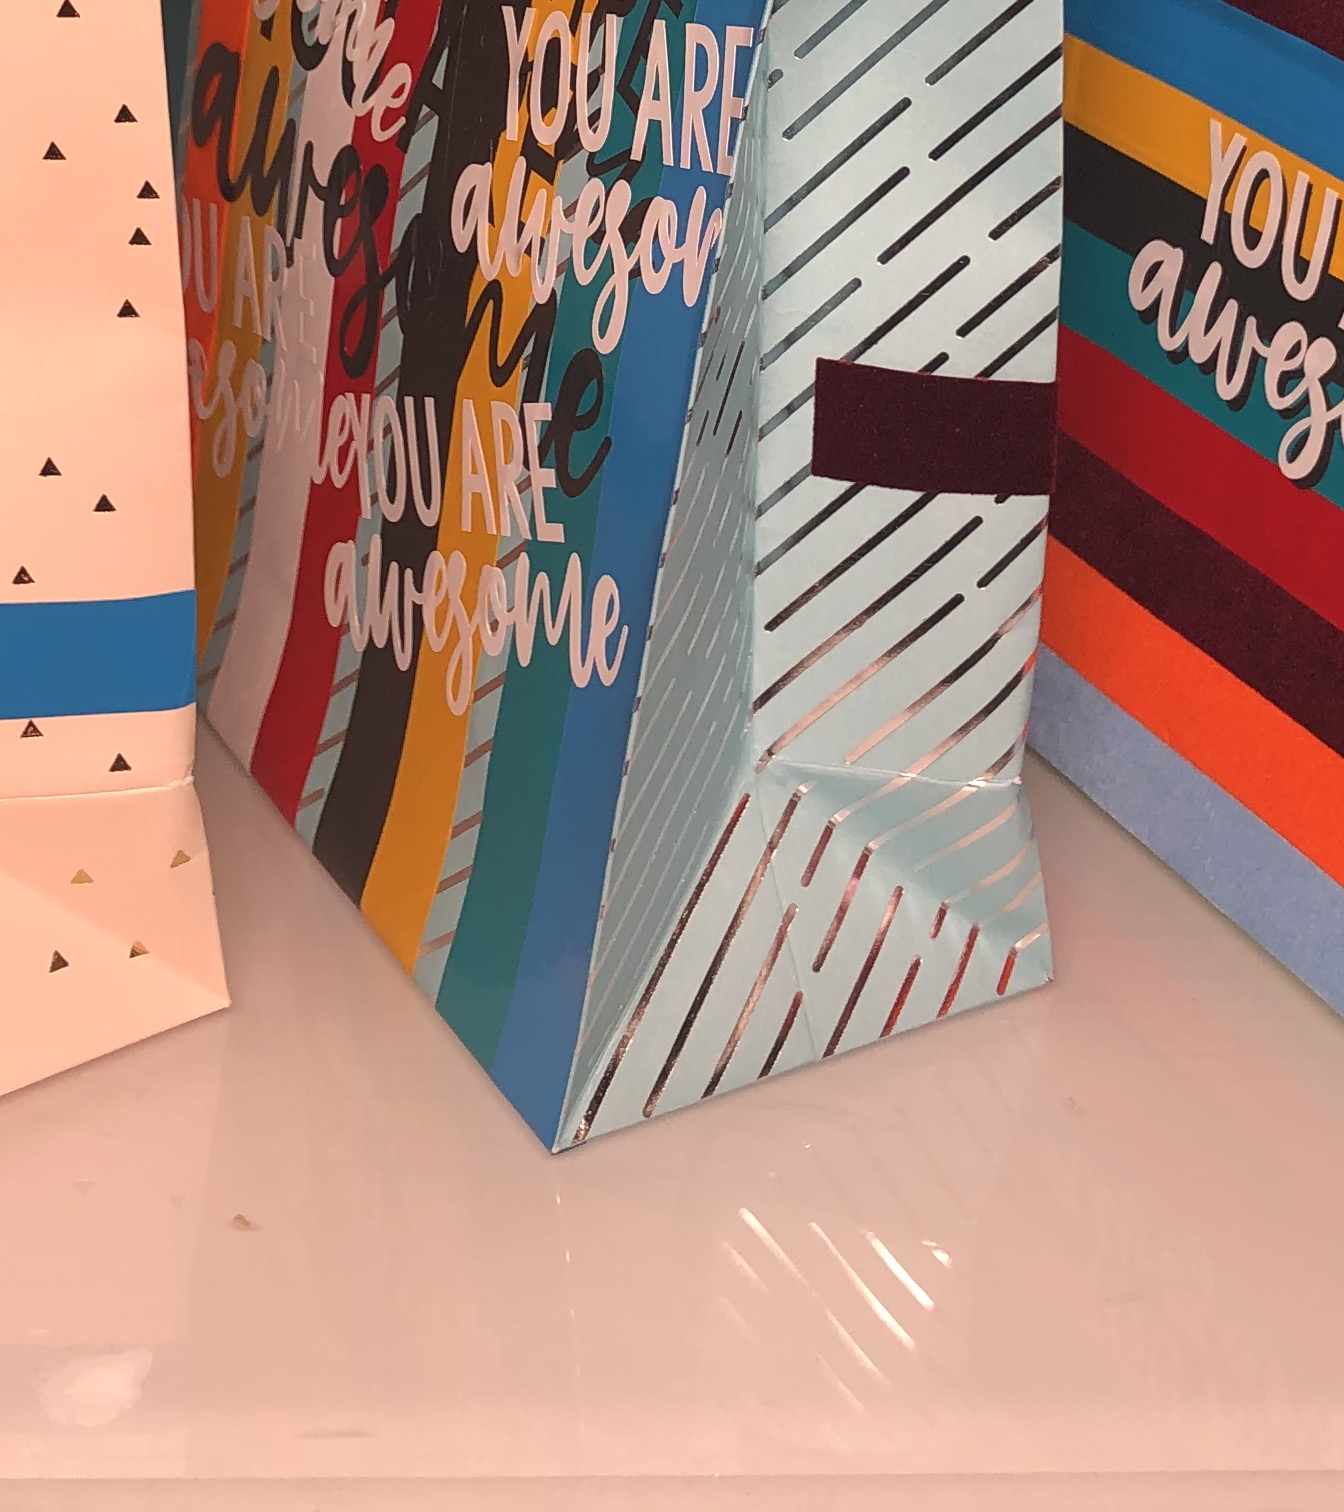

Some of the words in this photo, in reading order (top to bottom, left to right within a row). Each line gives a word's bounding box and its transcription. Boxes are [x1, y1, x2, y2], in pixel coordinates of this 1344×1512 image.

[500, 4, 622, 154] YOU
[630, 17, 755, 177] ARE
[1199, 117, 1342, 302] YOU
[352, 391, 443, 528] YOU
[459, 397, 566, 545] ARE
[322, 540, 630, 716] awesome
